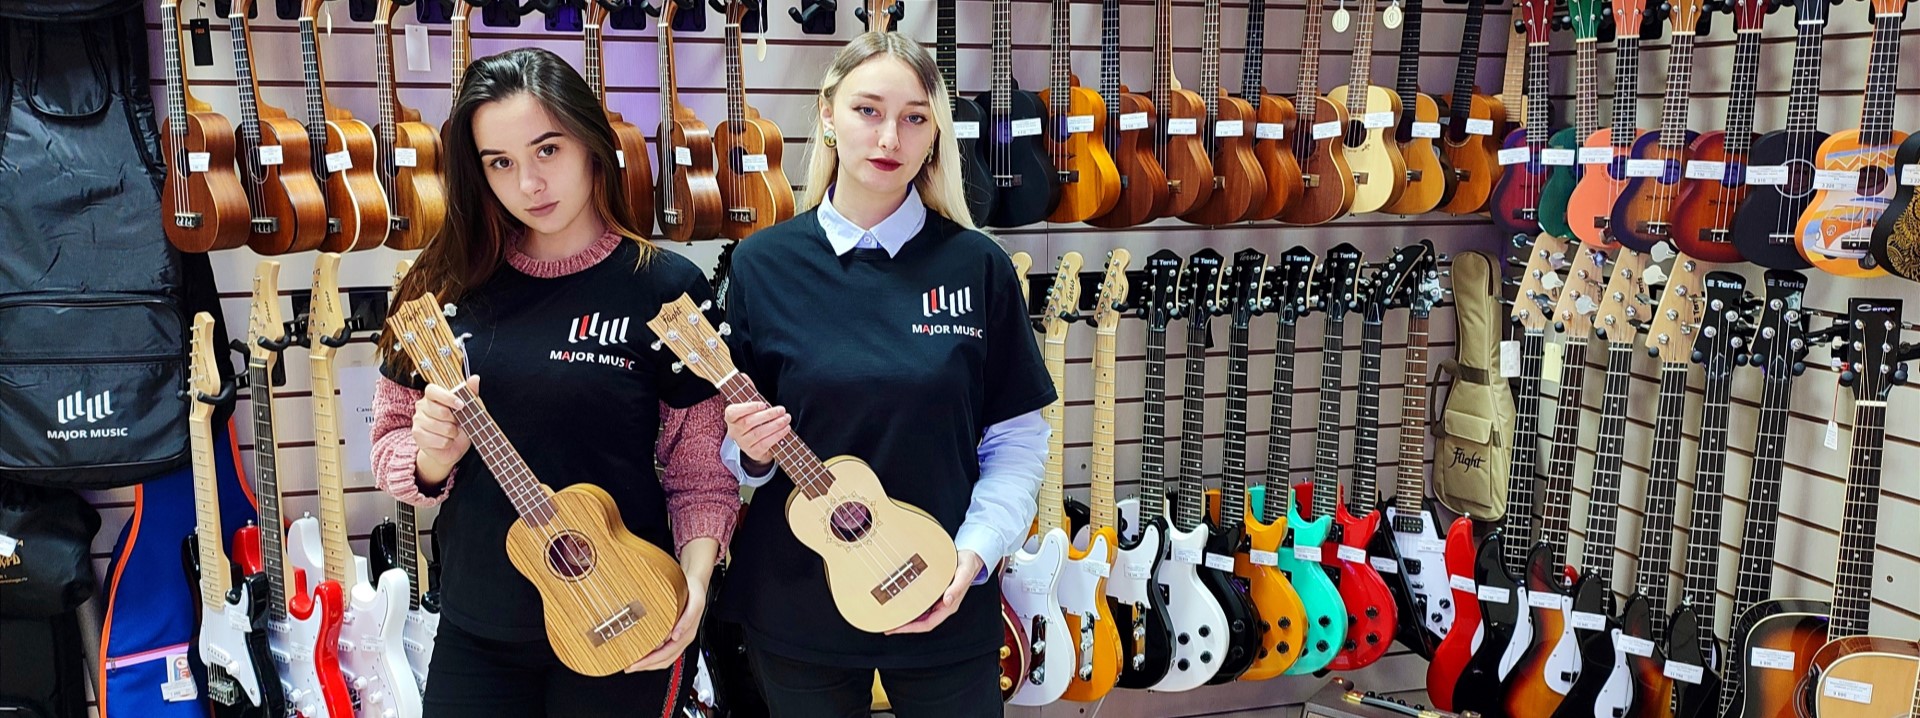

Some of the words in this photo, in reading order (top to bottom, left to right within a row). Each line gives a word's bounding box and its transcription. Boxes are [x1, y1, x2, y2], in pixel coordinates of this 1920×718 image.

[1200, 257, 1218, 265] Terris
[1340, 252, 1358, 260] Terris
[1717, 280, 1743, 290] Terris
[1778, 279, 1805, 289] Terris
[912, 324, 951, 336] MAJOR
[953, 324, 983, 339] MUSIC
[549, 350, 595, 363] MAJOR
[598, 354, 635, 370] MUSIC
[47, 430, 88, 441] MAJOR
[90, 427, 128, 438] MUSIC
[1448, 446, 1486, 473] Flight
